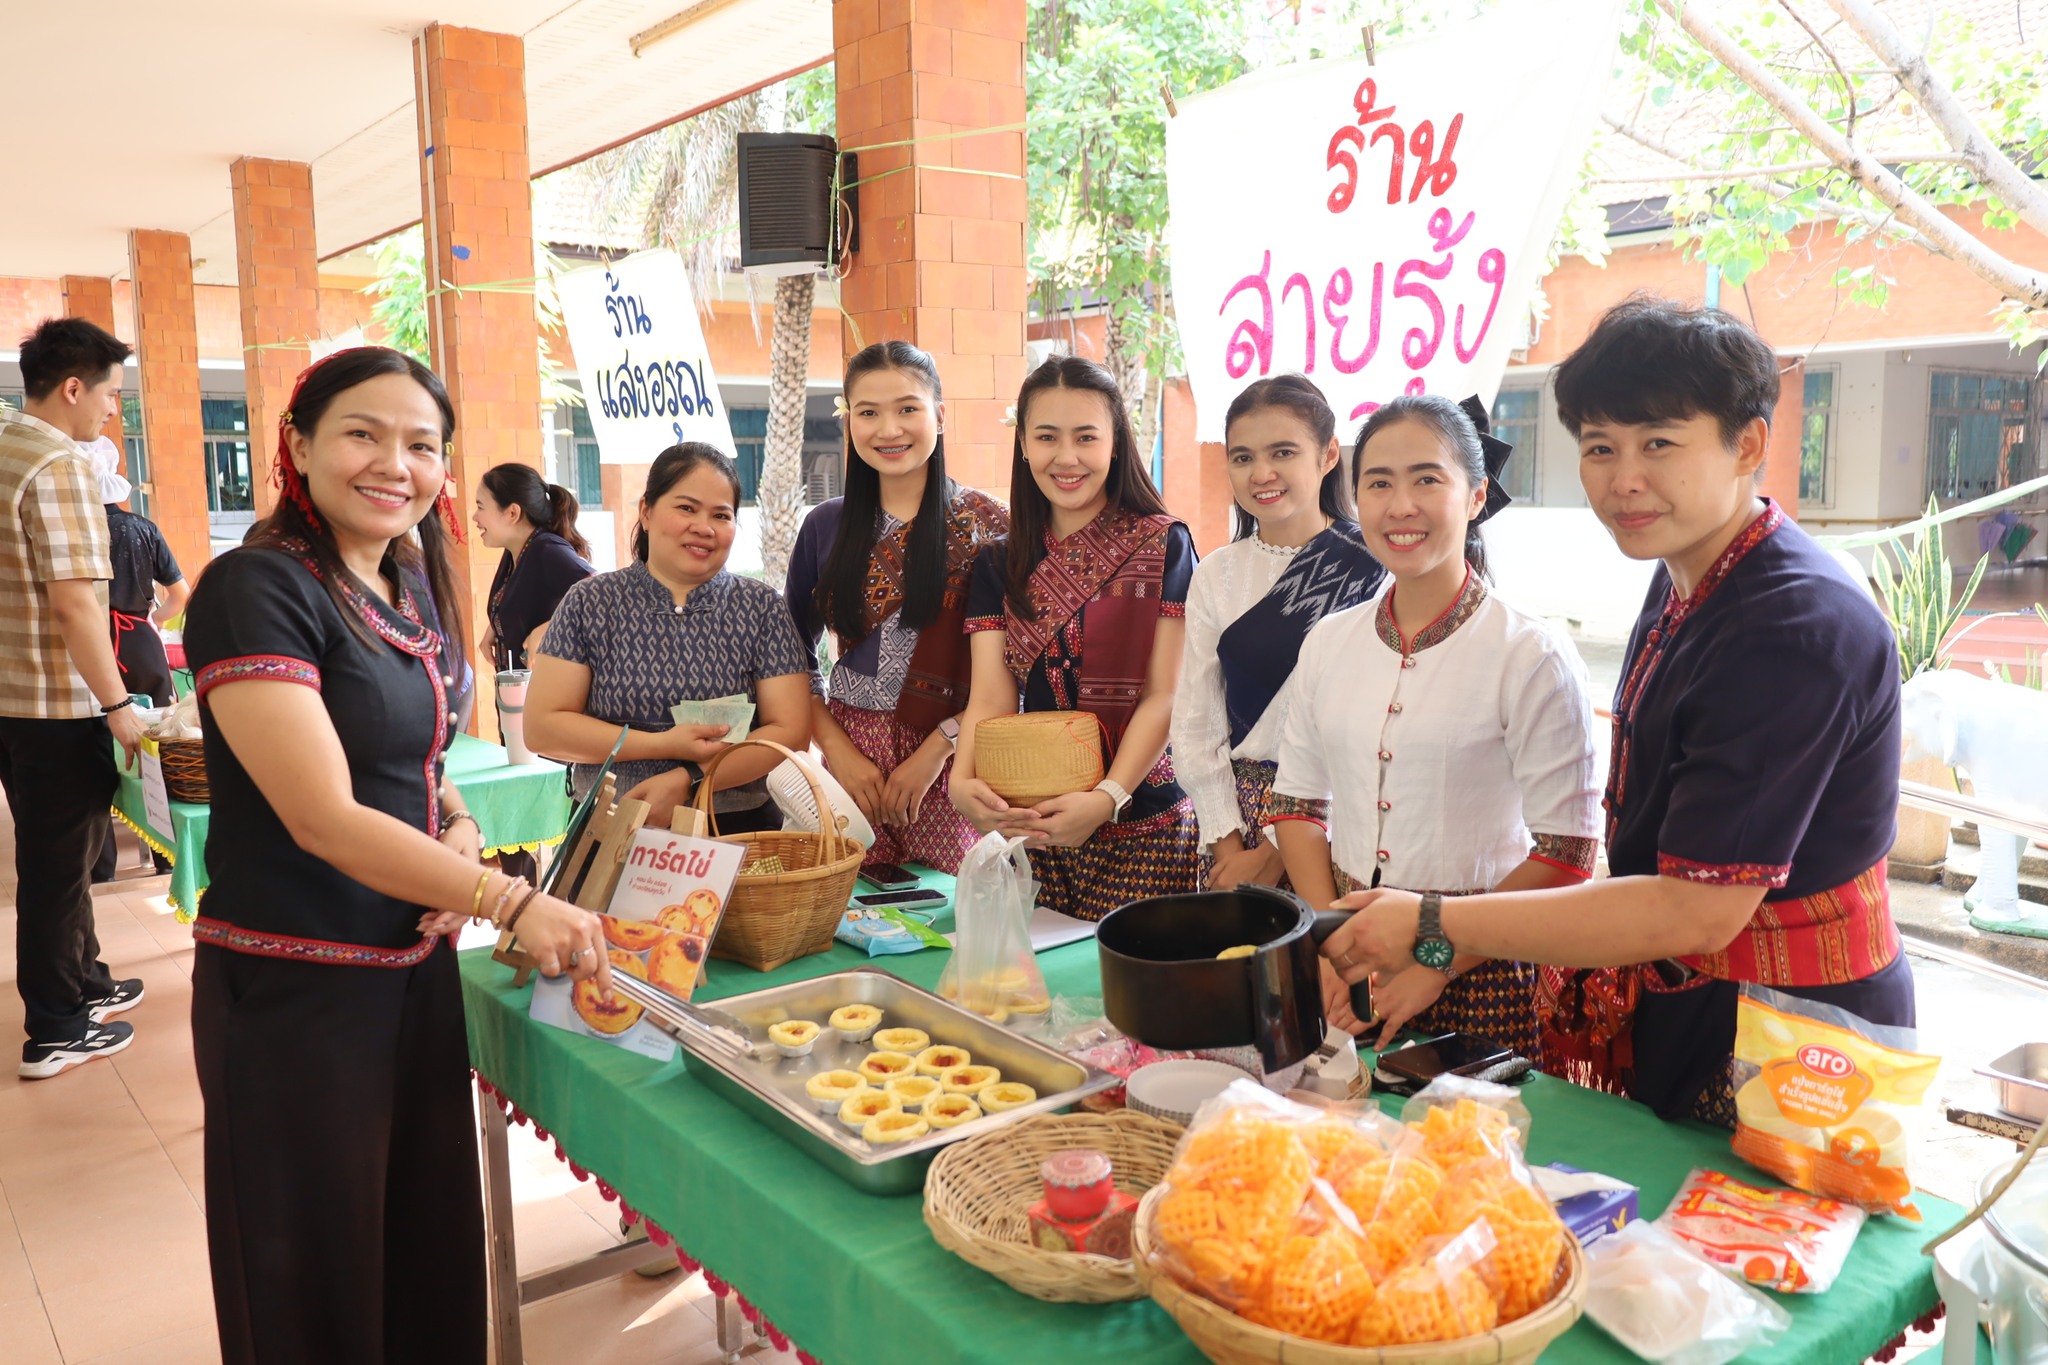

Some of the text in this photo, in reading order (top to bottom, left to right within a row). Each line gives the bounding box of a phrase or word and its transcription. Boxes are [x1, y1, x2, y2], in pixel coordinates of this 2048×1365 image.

[1326, 77, 1464, 214] ร้าน
[605, 271, 652, 338] ร้าน
[597, 348, 714, 446] แสงอรุณ
[629, 840, 716, 879] ทาร์ตไข่
[1805, 1048, 1848, 1074] aro
